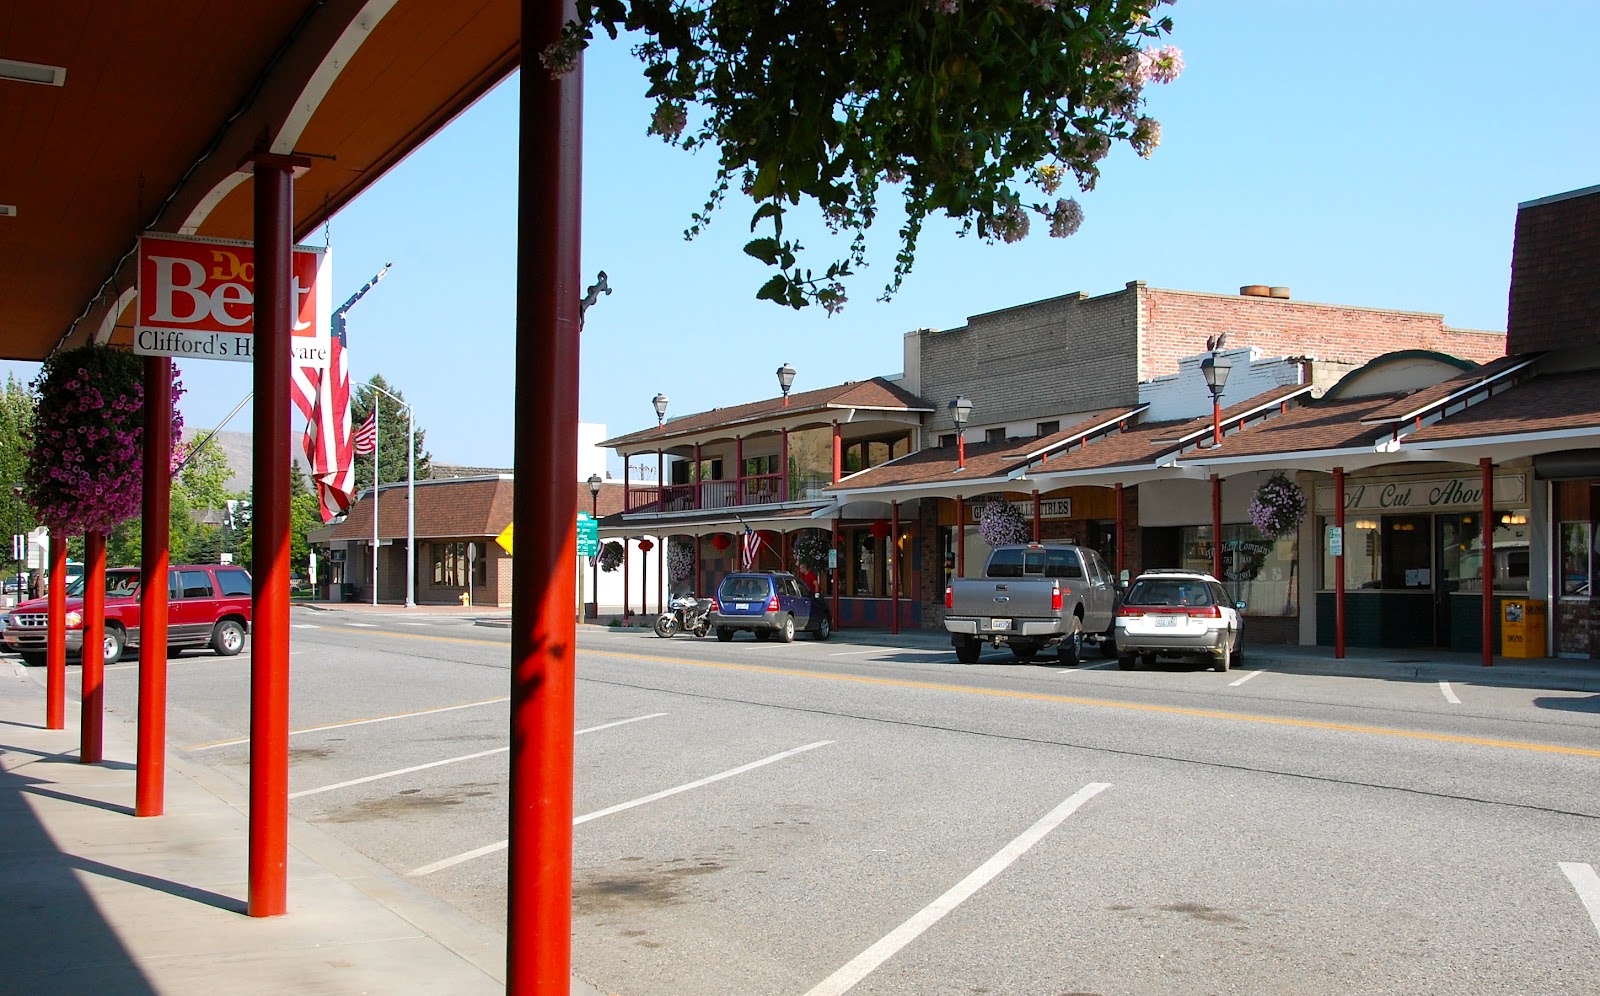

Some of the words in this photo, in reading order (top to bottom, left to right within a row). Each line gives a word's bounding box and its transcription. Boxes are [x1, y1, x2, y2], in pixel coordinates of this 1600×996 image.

[147, 255, 311, 331] Bet
[138, 330, 228, 355] Clifford's
[234, 337, 326, 360] Hare
[1344, 485, 1366, 509] A
[1379, 483, 1412, 508] Cut
[1429, 479, 1485, 506] Abov
